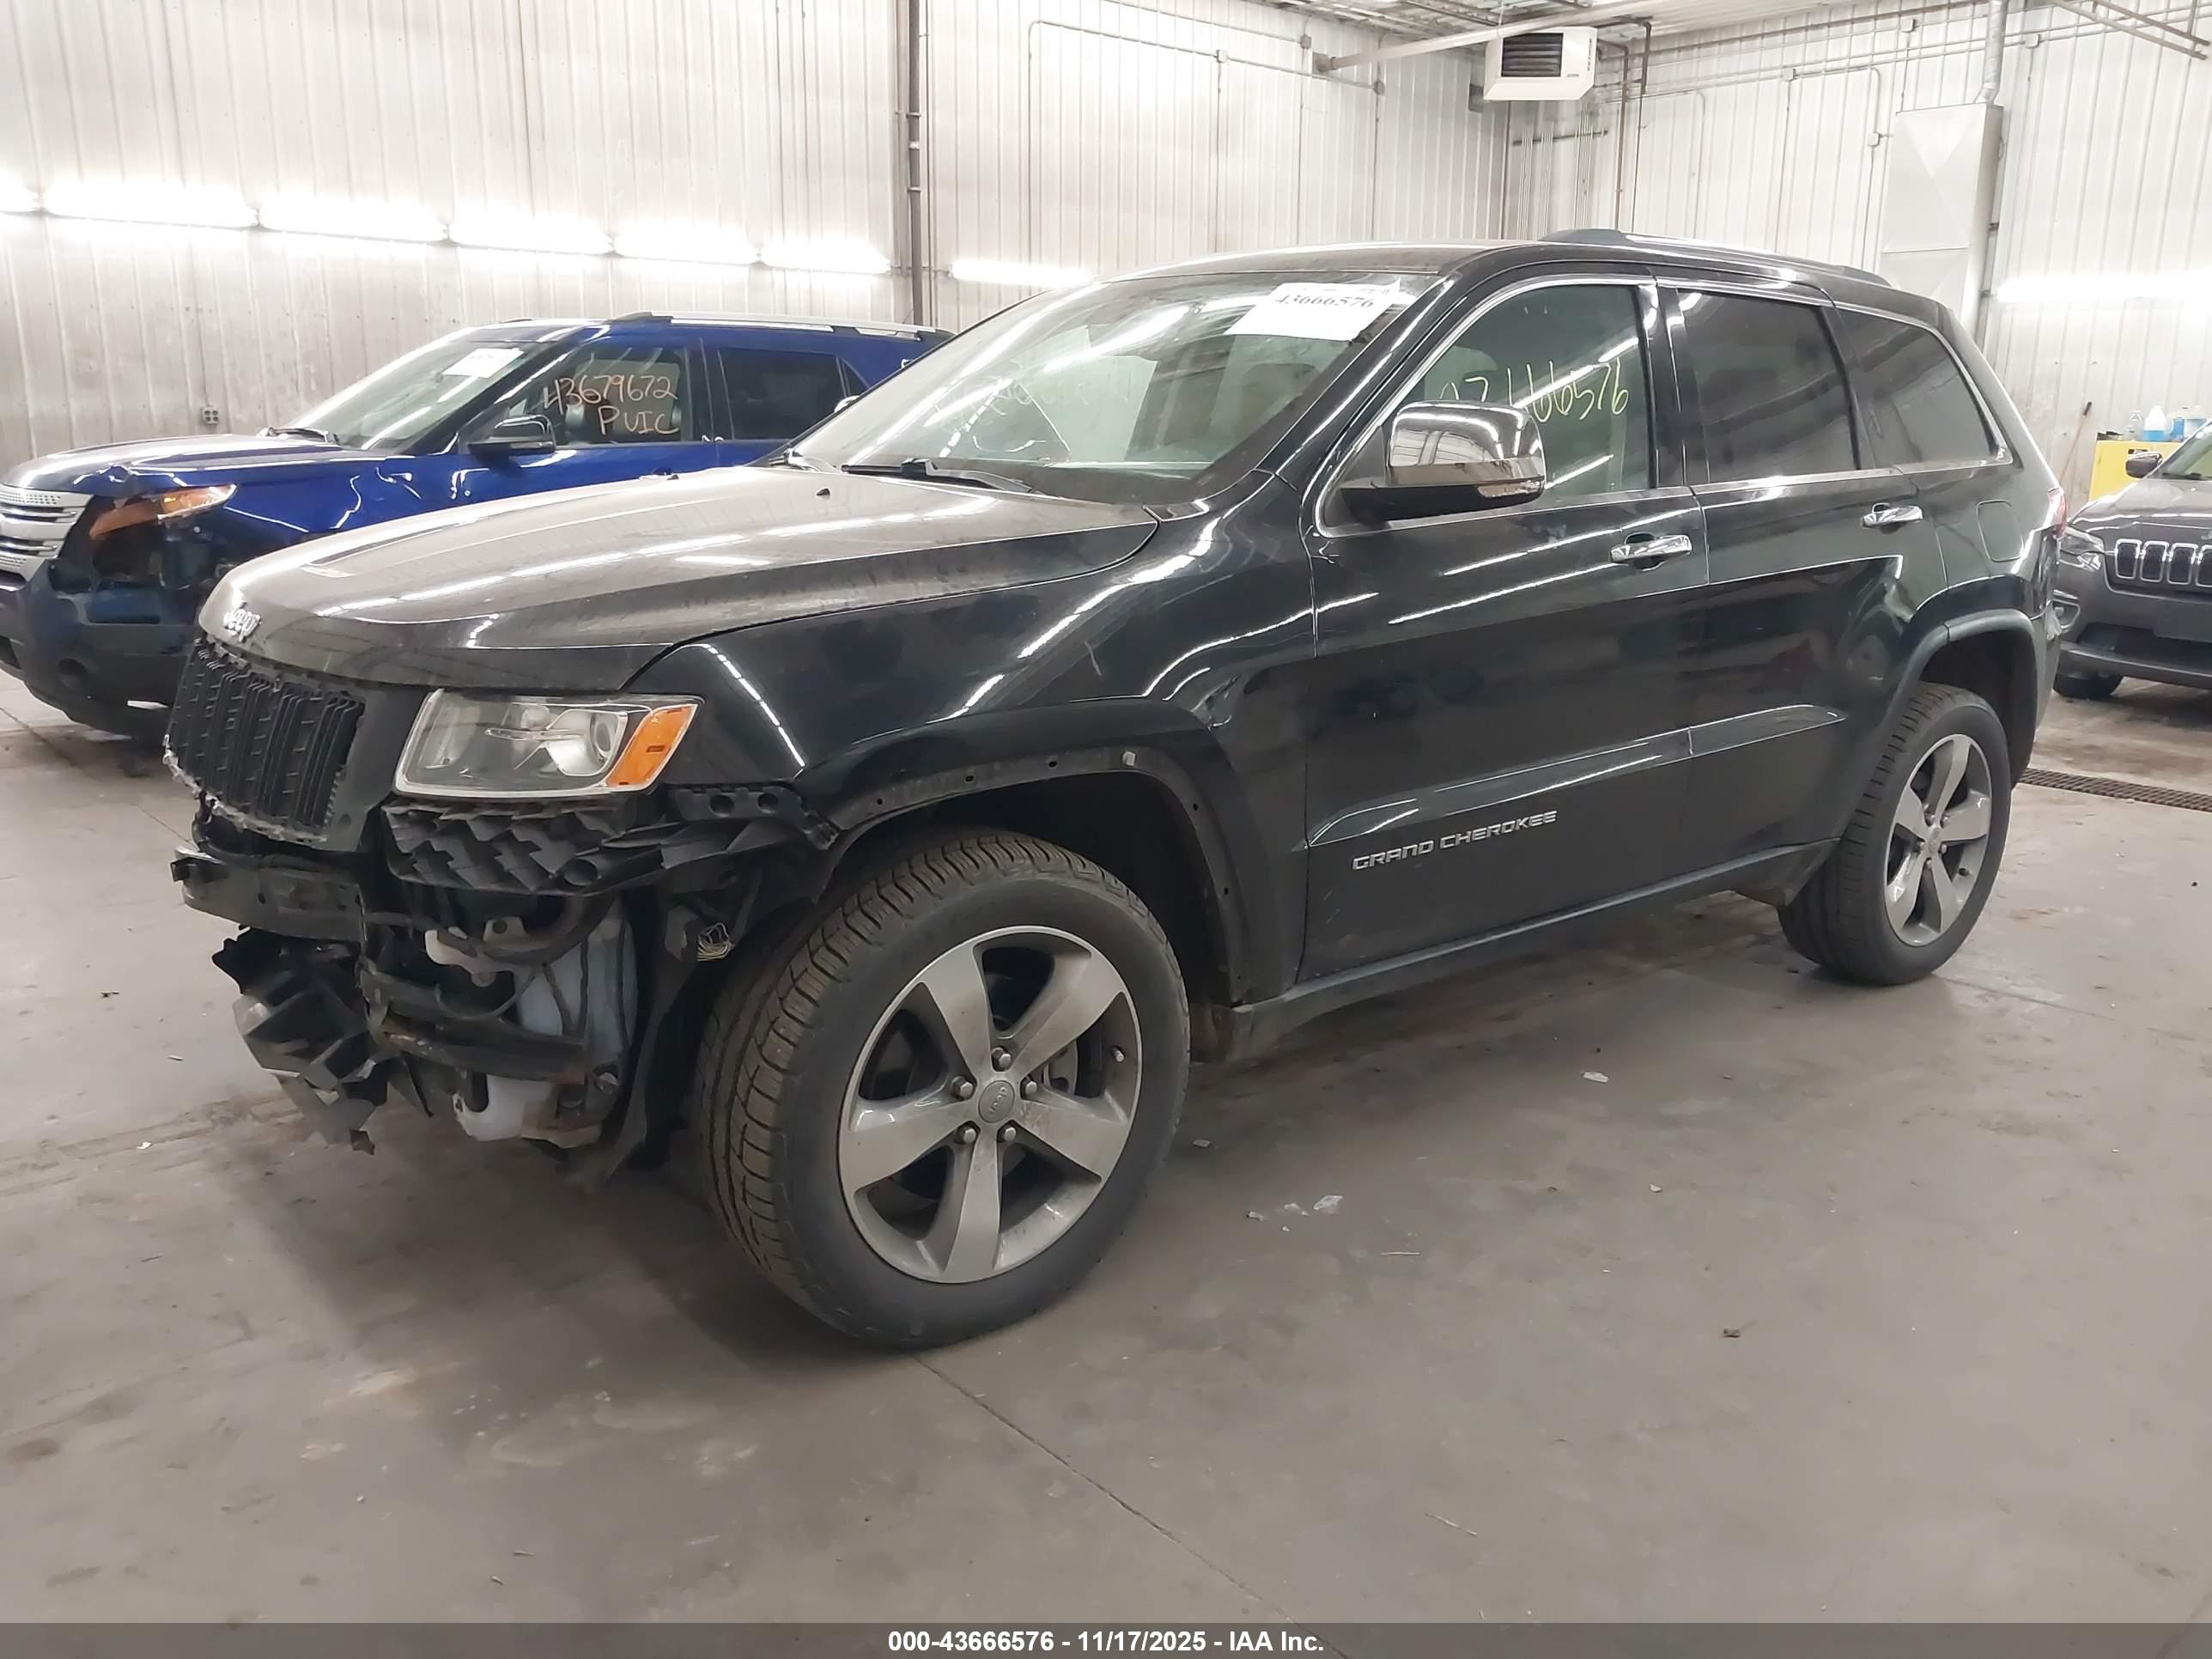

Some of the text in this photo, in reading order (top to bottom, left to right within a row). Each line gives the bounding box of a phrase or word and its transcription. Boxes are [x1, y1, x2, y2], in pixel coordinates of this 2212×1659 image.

[543, 375, 678, 416] 43679672
[223, 608, 261, 642] Jeep
[1352, 810, 1558, 870] GRAND CHEROKEE
